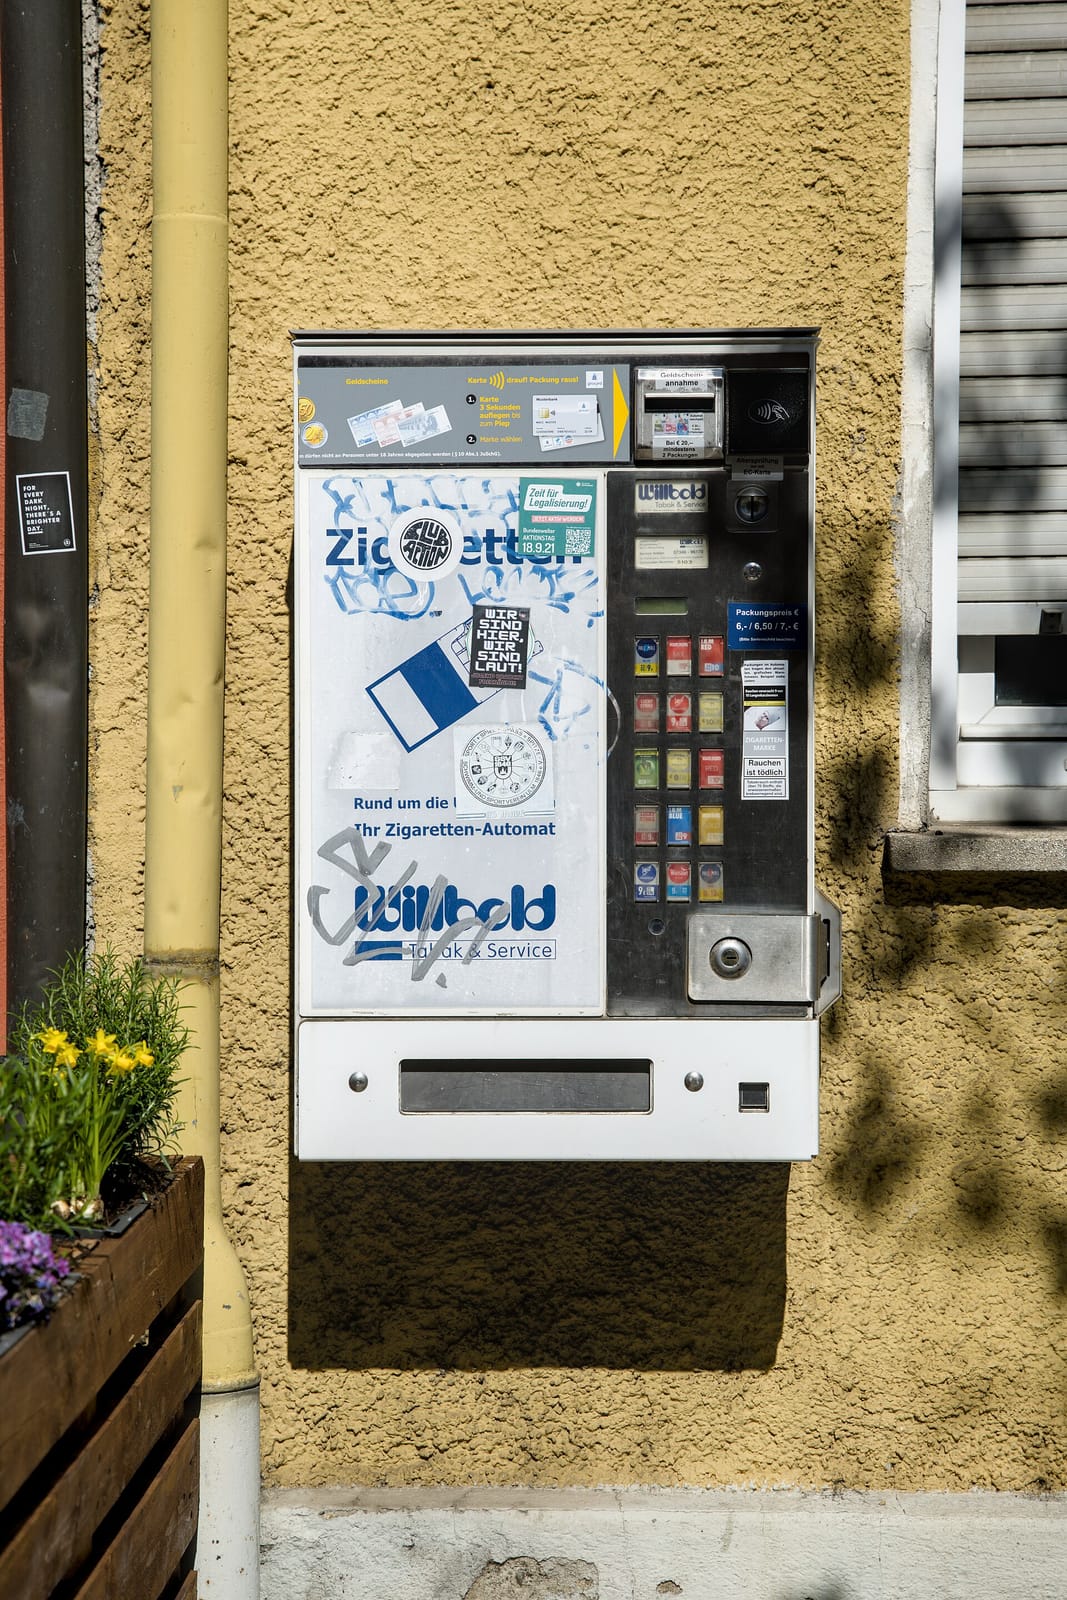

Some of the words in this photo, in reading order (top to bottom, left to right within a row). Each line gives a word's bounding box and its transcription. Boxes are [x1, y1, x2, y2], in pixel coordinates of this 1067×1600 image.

[529, 376, 559, 385] Packung
[560, 376, 579, 384] raus!
[479, 412, 511, 420] auflegen
[529, 488, 546, 497] Zeit
[546, 488, 560, 497] für
[638, 483, 706, 500] Willbold
[529, 497, 589, 510] Legalisierung!
[26, 517, 61, 525] BRIGHTER
[403, 521, 449, 546] CLUB
[522, 534, 556, 542] AKTIONSTAG
[522, 542, 555, 553] 18.9.21
[403, 541, 449, 567] ACTION
[485, 608, 518, 620] WIR
[735, 609, 793, 618] Packungspreis
[479, 619, 523, 631] SIND
[754, 622, 773, 631] 6,50
[476, 630, 524, 643] HIER,
[483, 641, 516, 651] WIR
[477, 651, 521, 662] SIND
[475, 661, 522, 673] LAUT!
[746, 768, 756, 776] ist
[756, 768, 783, 776] tödlich
[354, 796, 393, 809] Rund
[397, 799, 421, 809] um
[425, 796, 449, 809] die
[385, 822, 556, 840] Zigaretten-Automat
[354, 884, 556, 932] Willbold
[469, 943, 481, 958] &
[487, 943, 552, 958] Service
